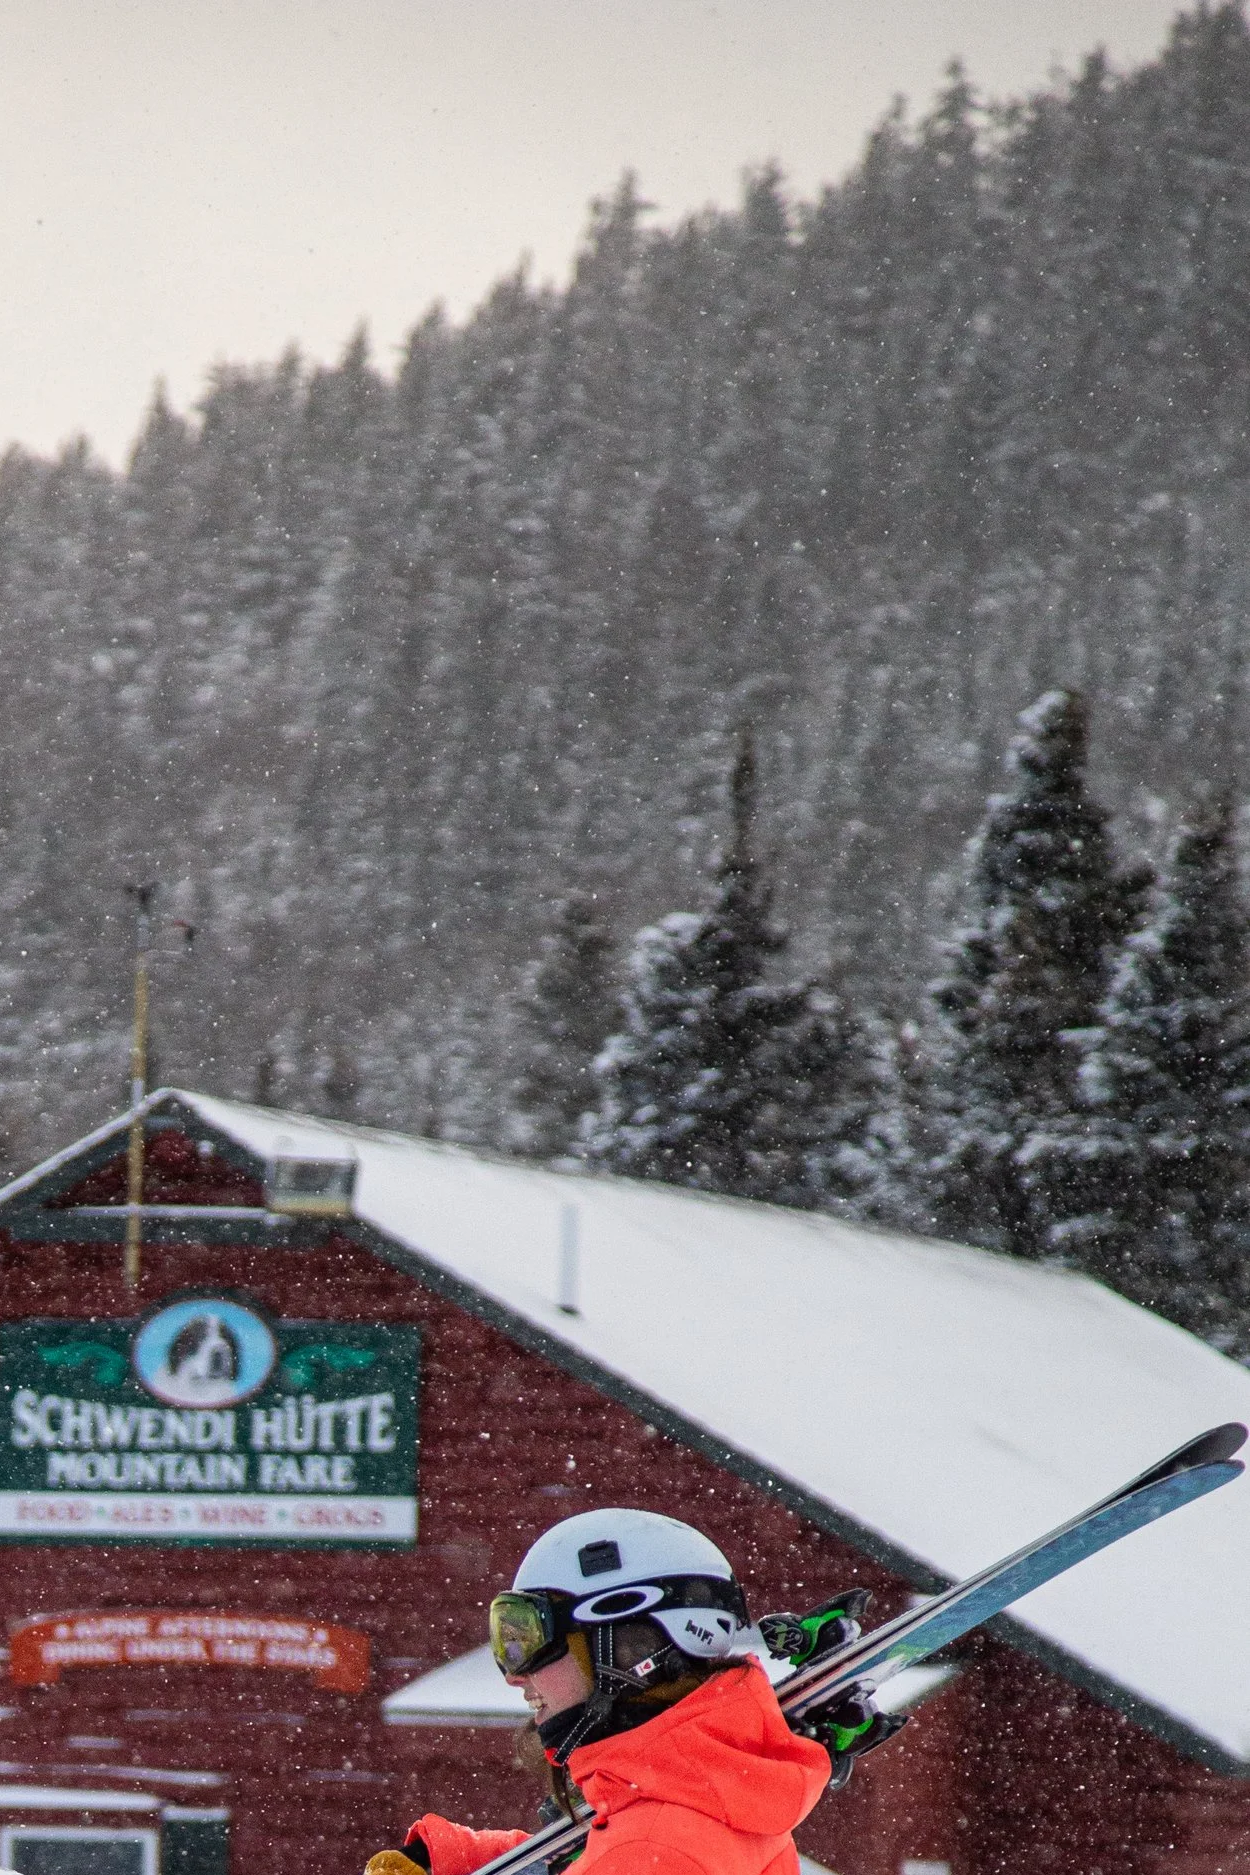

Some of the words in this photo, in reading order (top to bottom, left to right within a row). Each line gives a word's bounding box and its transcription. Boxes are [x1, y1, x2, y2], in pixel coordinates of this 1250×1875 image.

[11, 1389, 237, 1450] SCHWENDI
[250, 1391, 397, 1453] HÜTTE
[47, 1451, 249, 1490] MOUNTAIN
[258, 1454, 357, 1492] FARE
[16, 1499, 92, 1522] FOOD
[110, 1503, 174, 1524] ALES
[199, 1504, 267, 1526] WINE
[211, 1641, 257, 1664] THE
